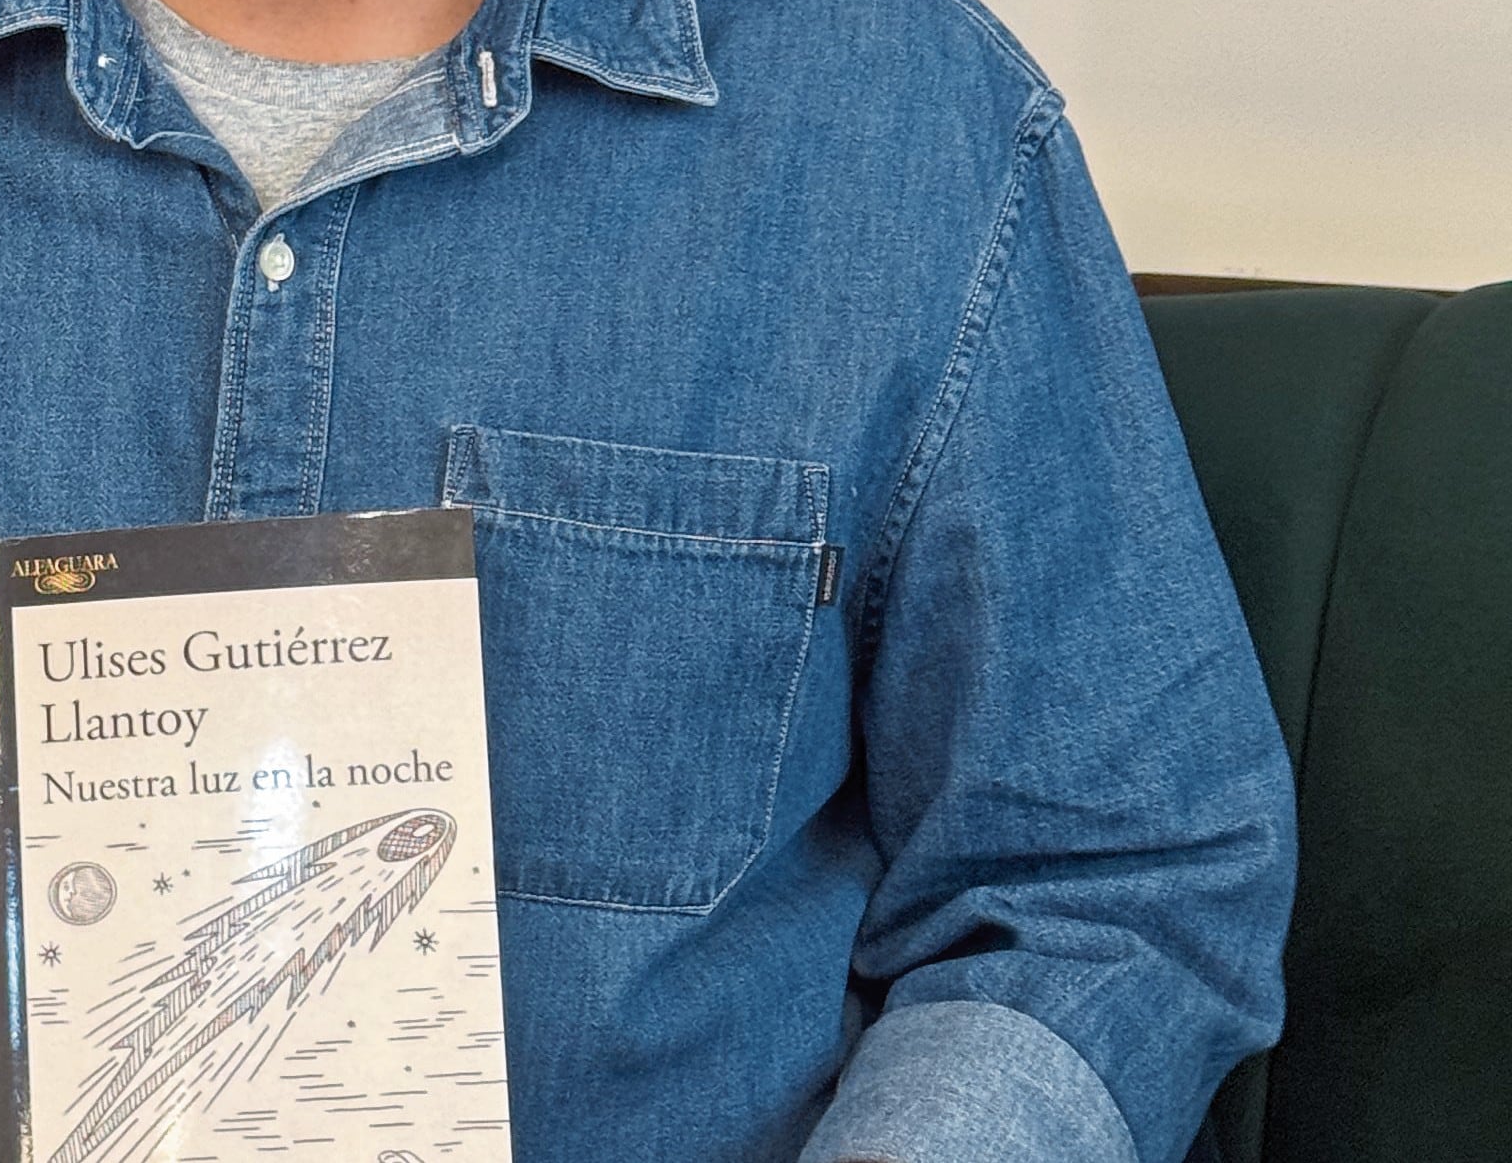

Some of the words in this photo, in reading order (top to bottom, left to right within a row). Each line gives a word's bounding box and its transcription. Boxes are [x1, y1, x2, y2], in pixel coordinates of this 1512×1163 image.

[11, 553, 119, 579] ALFAGUARA
[38, 637, 167, 682] Ulises
[183, 626, 393, 673] Gutiérrez
[41, 700, 209, 748] Llantoy
[41, 771, 178, 806] Nuestra
[189, 761, 241, 795] luz
[252, 769, 294, 792] en
[305, 755, 334, 789] la
[346, 749, 454, 788] noche
